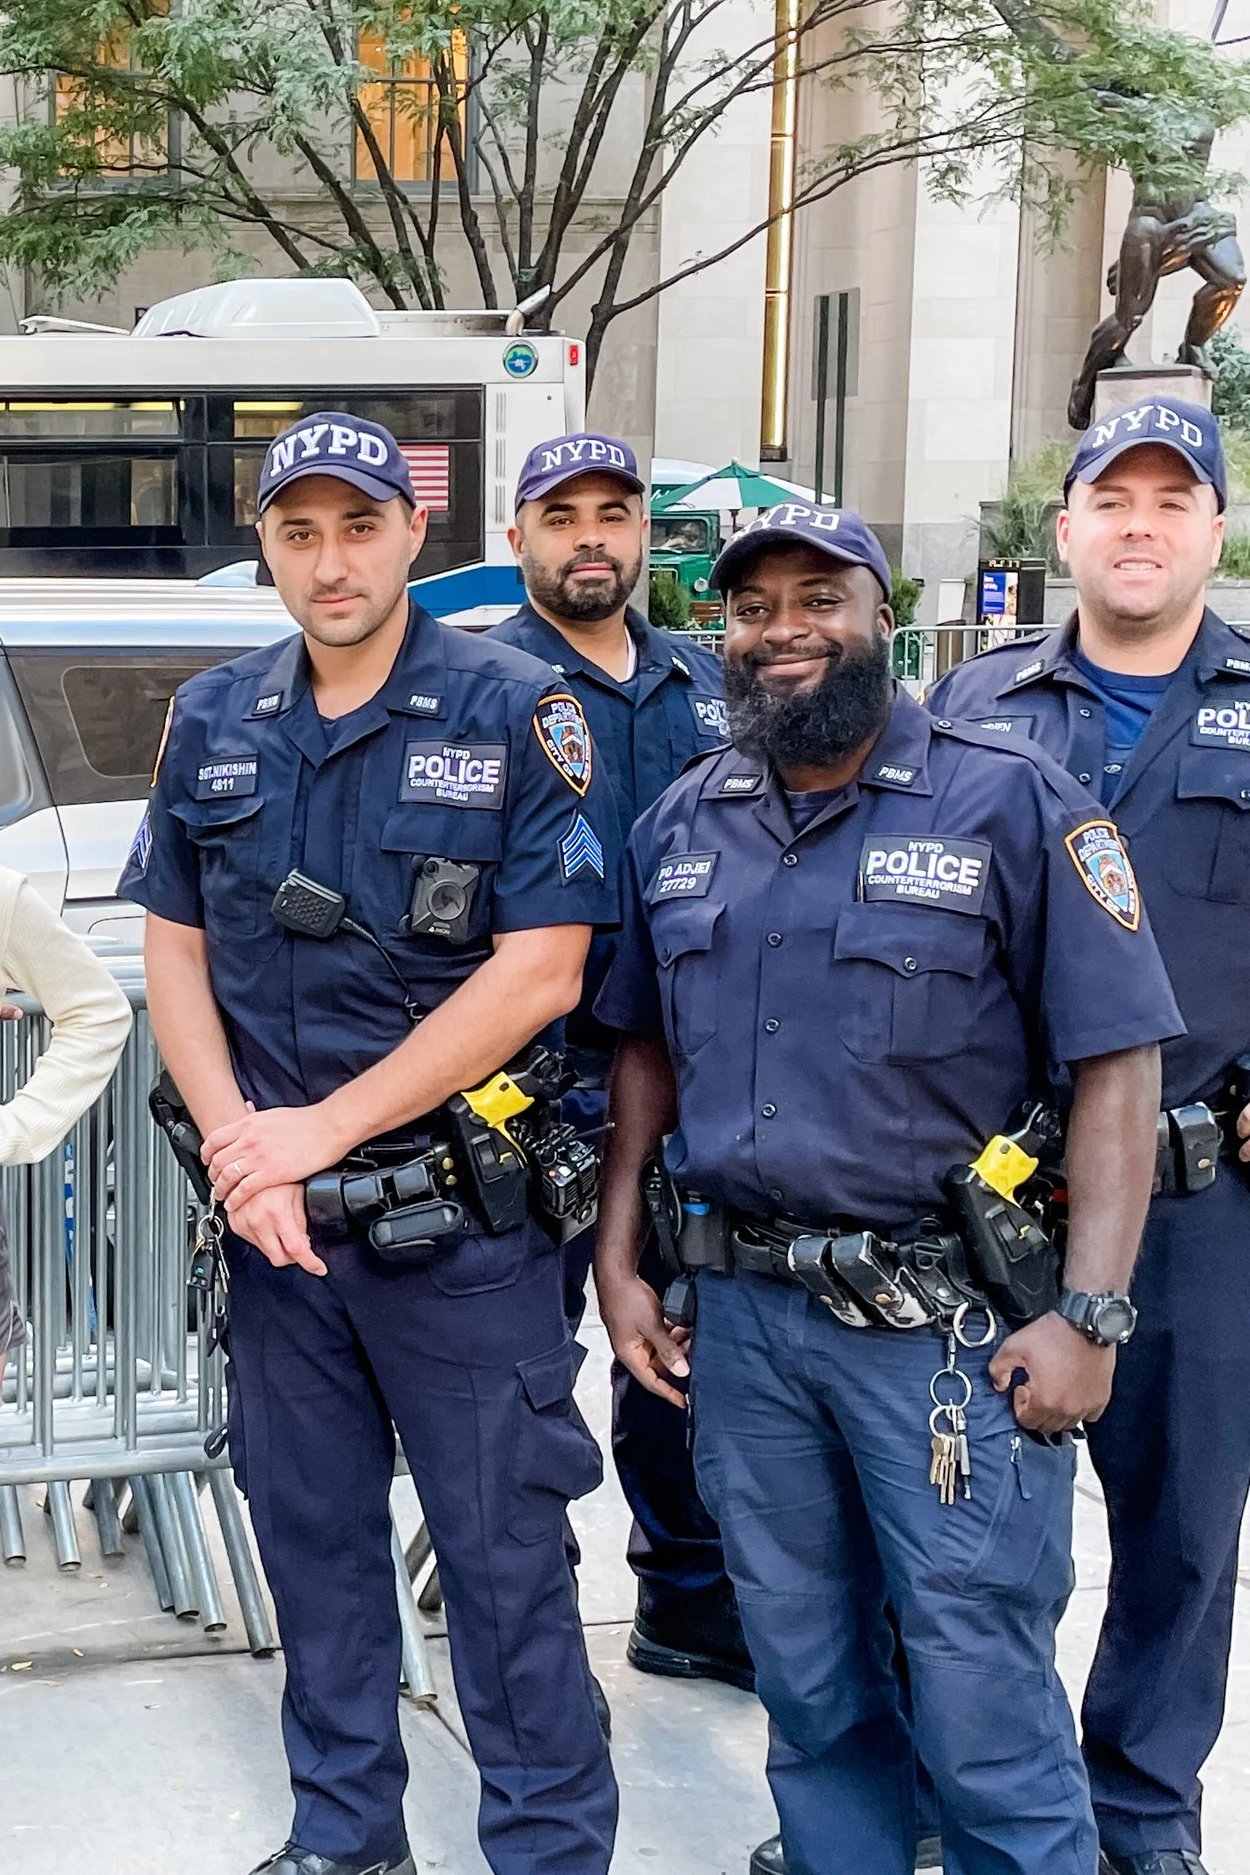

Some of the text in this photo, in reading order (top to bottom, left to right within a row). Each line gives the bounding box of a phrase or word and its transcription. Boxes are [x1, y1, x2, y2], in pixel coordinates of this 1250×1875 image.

[1092, 404, 1203, 449] NYPD
[269, 423, 389, 478] NYPD
[541, 439, 626, 472] NYPD
[409, 694, 438, 709] PBMS
[408, 754, 501, 784] POLICE
[877, 765, 913, 782] PBMS
[723, 778, 754, 790] PBMS
[908, 841, 944, 853] NYPD
[865, 850, 982, 887] POLICE
[659, 876, 697, 893] 27729
[868, 875, 972, 896] COUNTERTERRORISM
[895, 884, 940, 899] BUREAU
